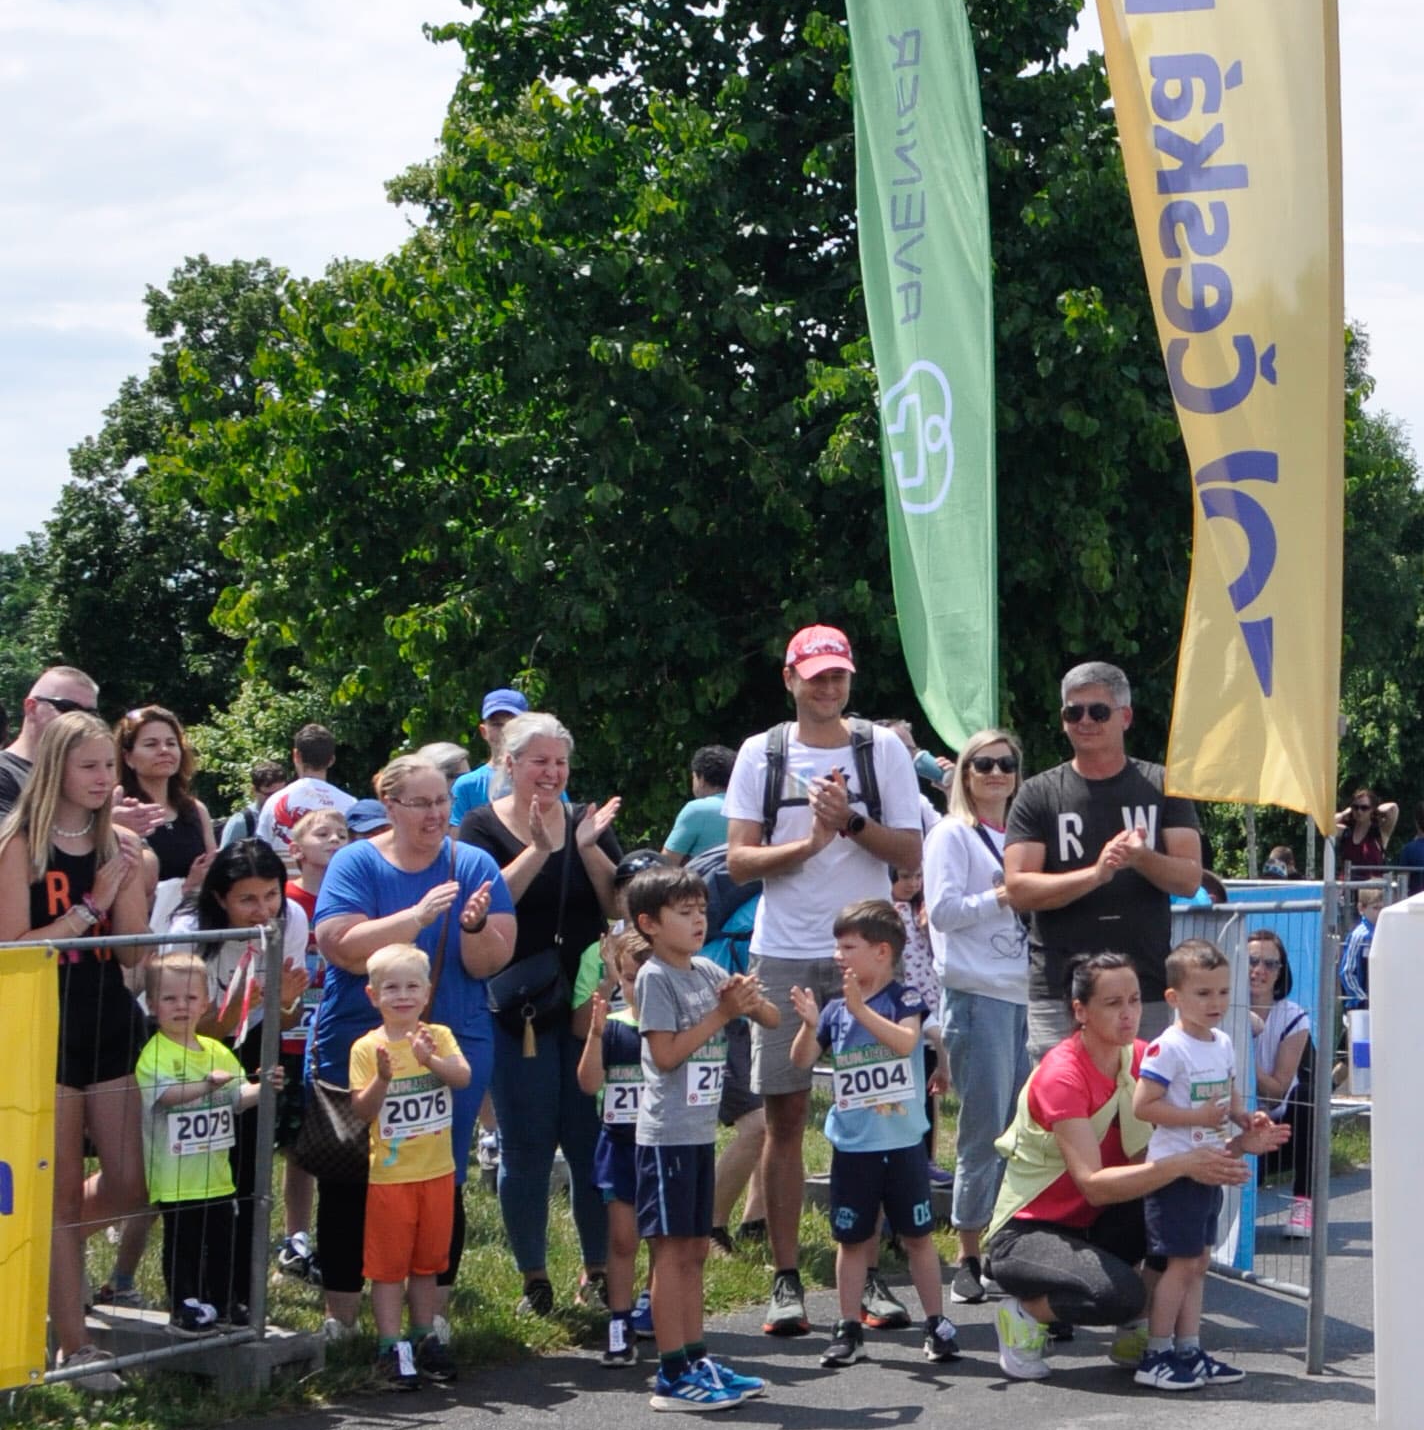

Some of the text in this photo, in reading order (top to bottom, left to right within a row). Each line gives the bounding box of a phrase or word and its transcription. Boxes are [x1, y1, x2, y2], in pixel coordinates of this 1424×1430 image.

[697, 1066, 723, 1090] 21
[840, 1062, 907, 1097] 2004
[385, 1091, 446, 1124] 2076
[614, 1086, 645, 1109] 21
[177, 1109, 231, 1141] 2079
